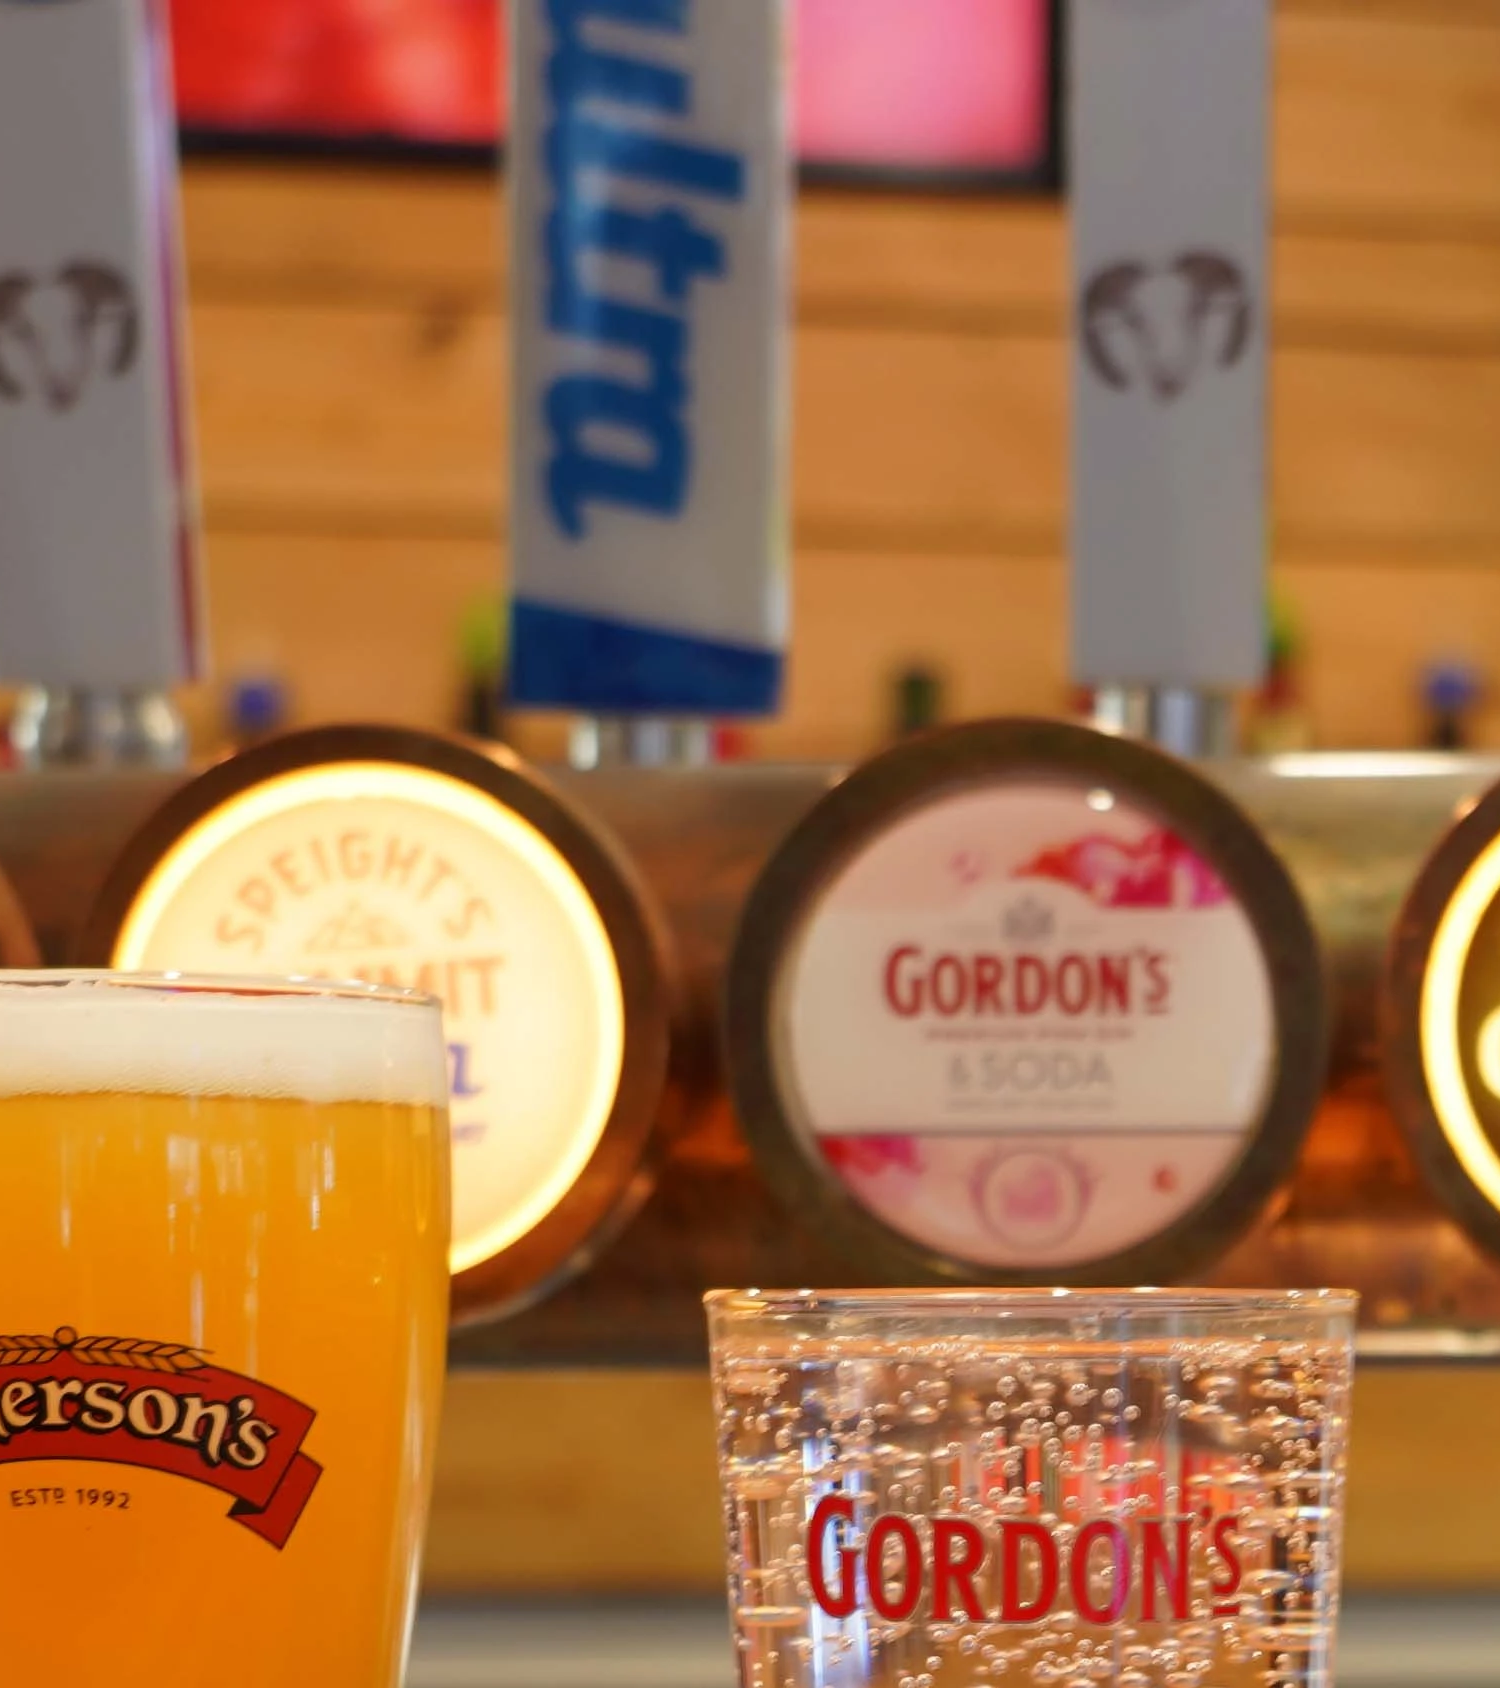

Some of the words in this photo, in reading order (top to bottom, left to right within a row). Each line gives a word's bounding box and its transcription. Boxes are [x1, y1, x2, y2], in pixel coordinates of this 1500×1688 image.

[214, 825, 494, 954] SPEIGHT'S
[883, 943, 1171, 1019] GORDON'S
[980, 1050, 1115, 1093] SODA
[76, 1488, 130, 1509] 1992
[806, 1494, 1242, 1625] GORDON'S
